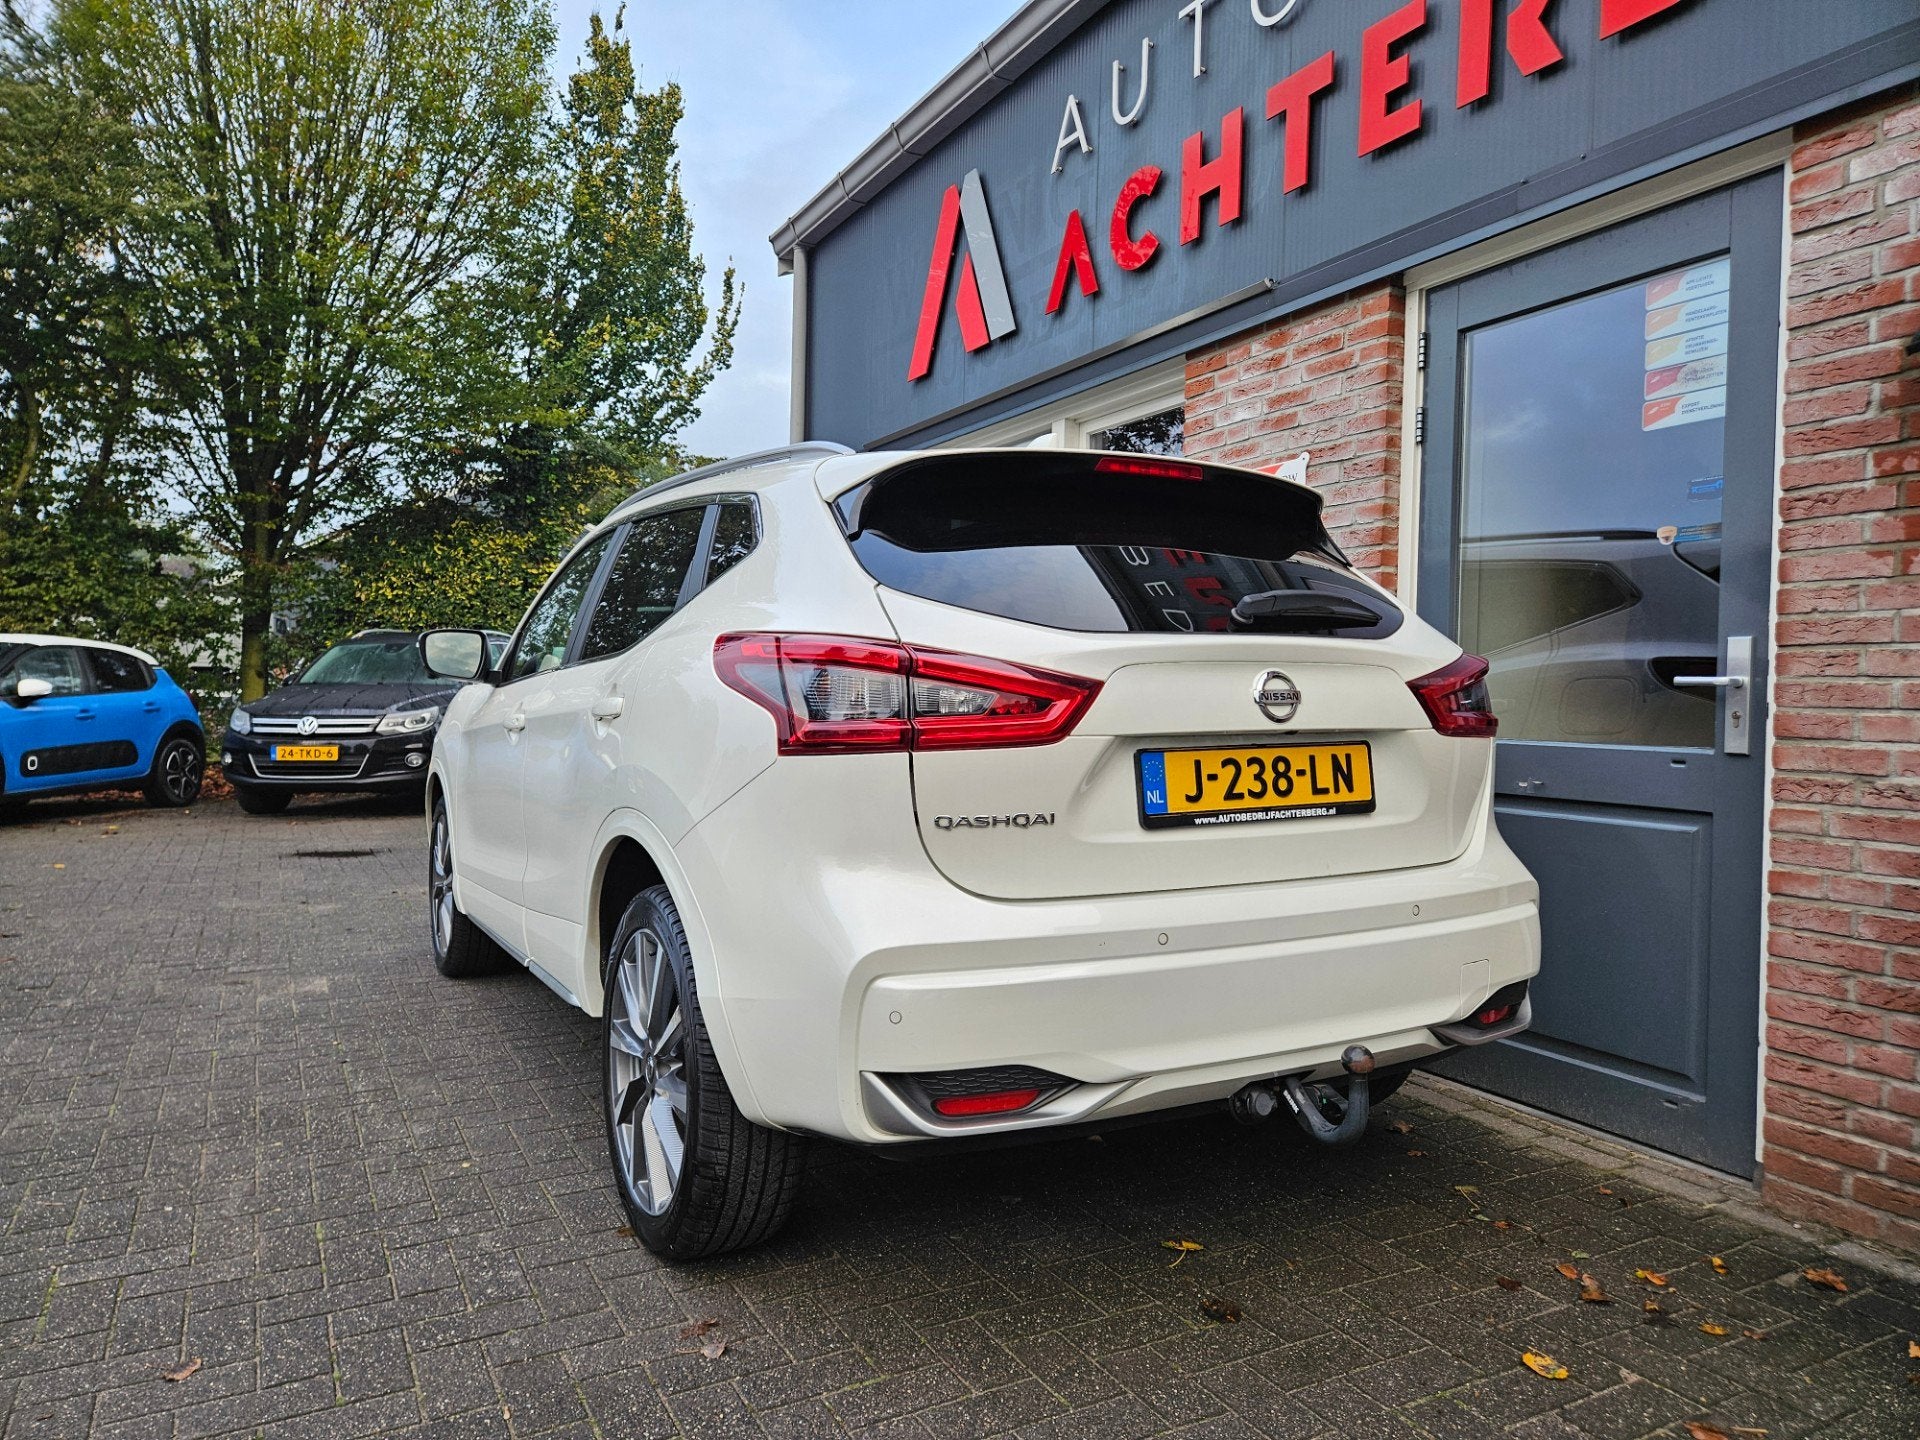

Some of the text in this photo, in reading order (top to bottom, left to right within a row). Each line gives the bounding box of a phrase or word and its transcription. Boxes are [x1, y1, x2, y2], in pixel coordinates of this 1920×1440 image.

[1260, 692, 1299, 701] NISSAN
[281, 749, 333, 758] 24-TKD-6
[1185, 753, 1354, 803] J-238-LN
[1147, 790, 1164, 803] NL
[934, 812, 1055, 831] QASHQAI
[1194, 807, 1336, 825] www.AUTOBEDRIJFACHTERBERG.nl
